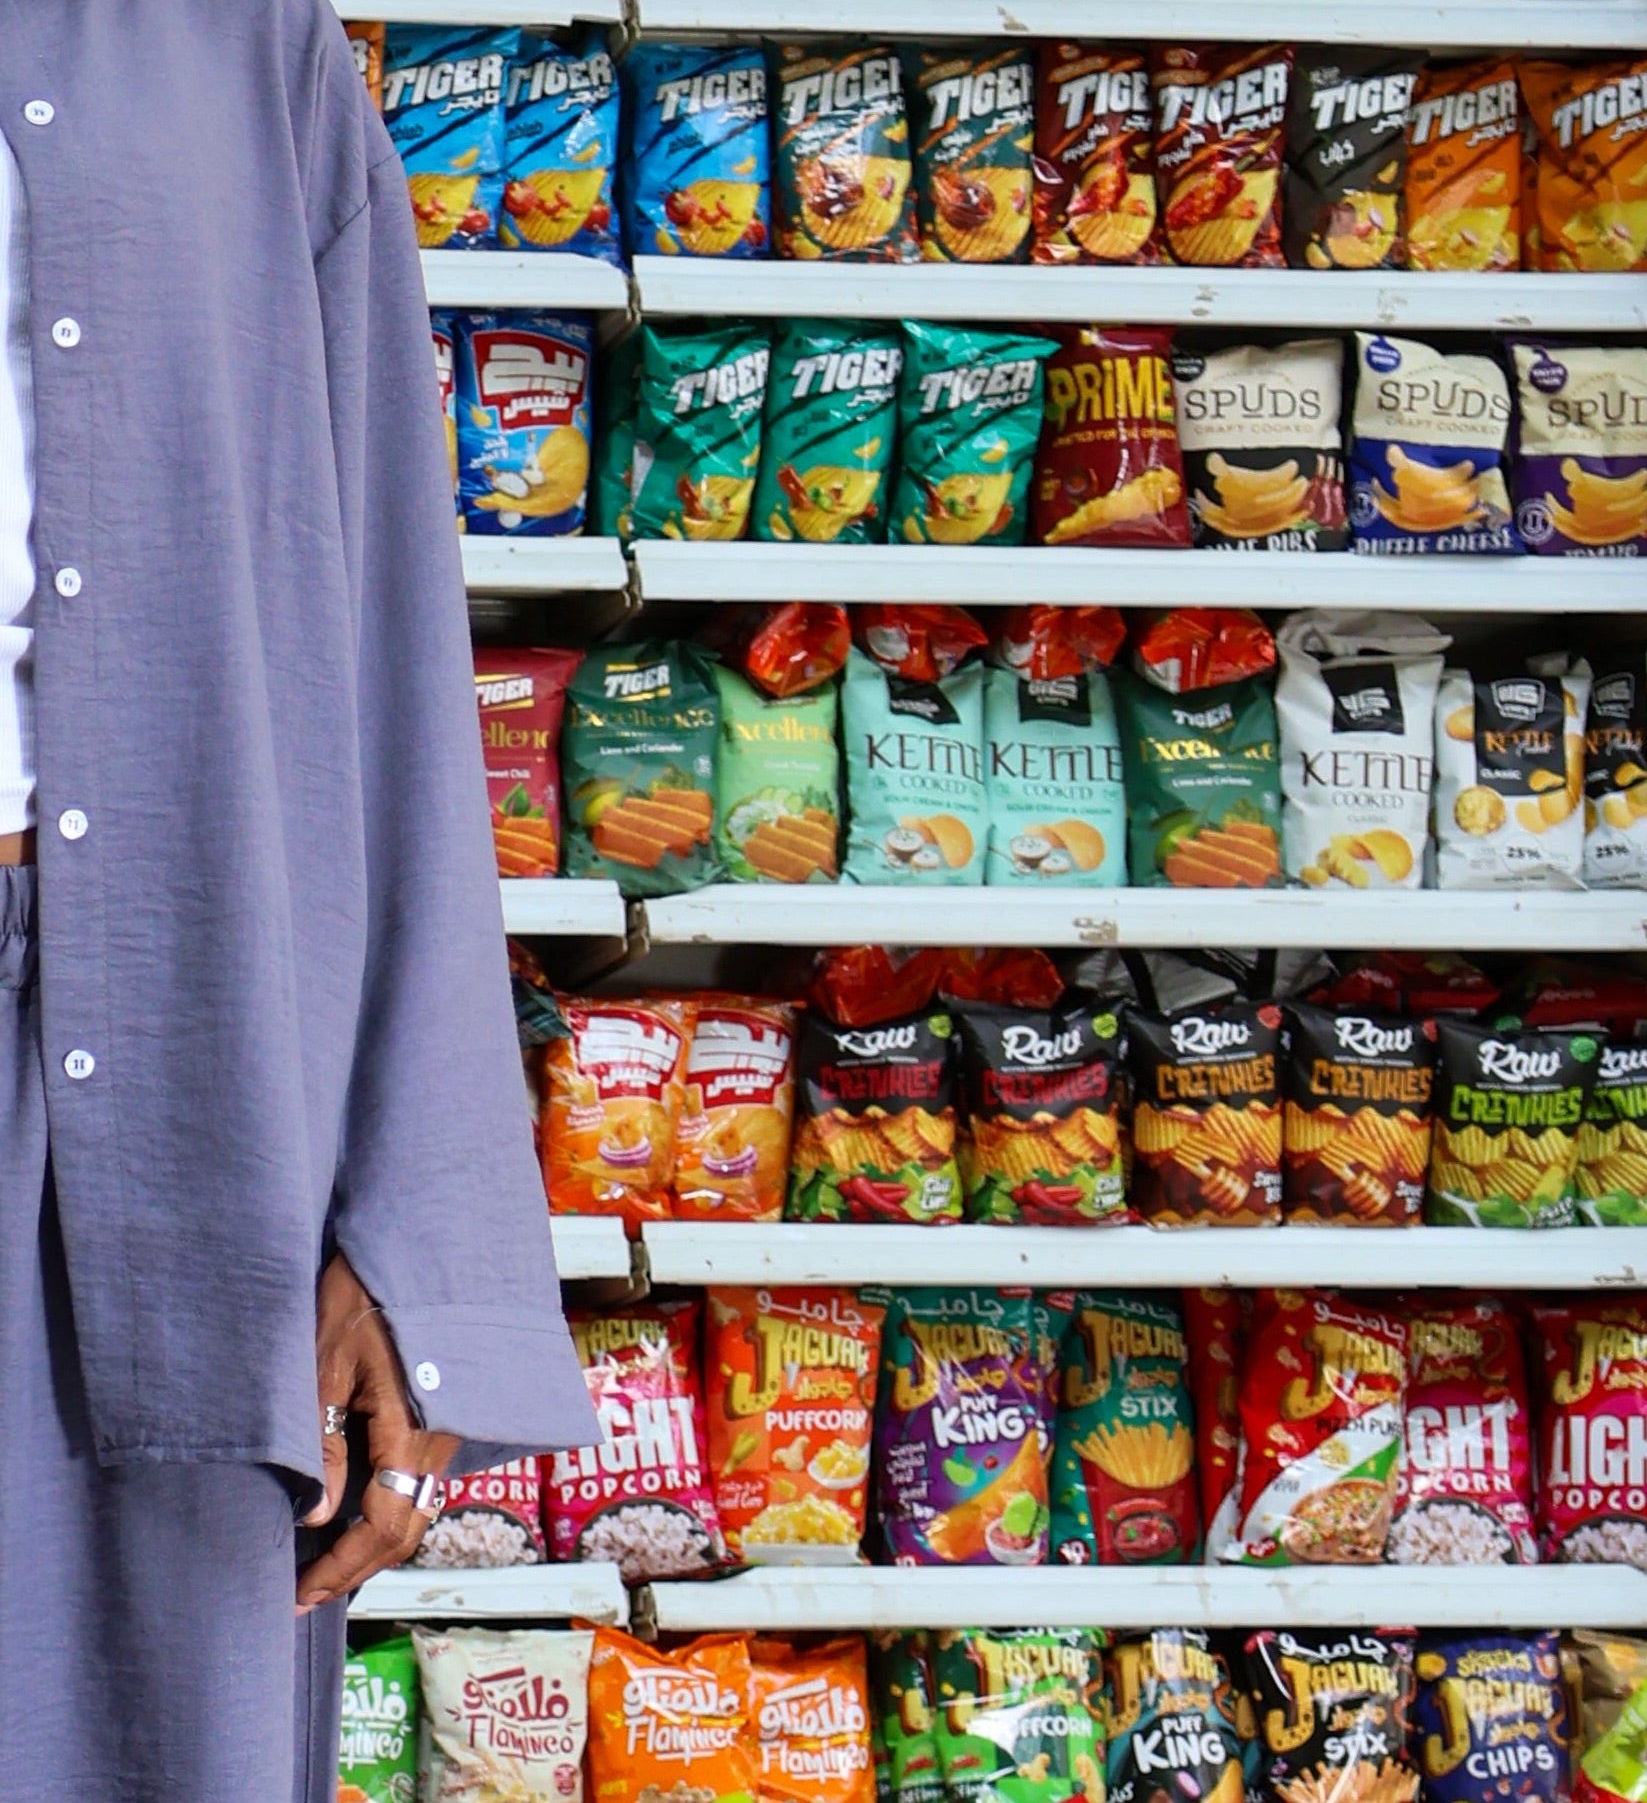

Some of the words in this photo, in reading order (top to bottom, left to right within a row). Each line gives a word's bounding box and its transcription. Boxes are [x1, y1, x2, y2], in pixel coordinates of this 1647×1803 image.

[384, 54, 503, 110] TIGER
[507, 53, 614, 107] TIGER
[657, 69, 766, 123] TIGER
[1160, 62, 1288, 129] TIGER
[1411, 79, 1517, 144] TIGER
[920, 360, 1036, 413] TIGER
[1049, 356, 1174, 430] PRIME
[1184, 382, 1322, 421] SPUDS
[1377, 378, 1511, 423] SPUDS
[604, 664, 670, 698] TIGER
[1301, 751, 1432, 792] KETTLE
[1332, 792, 1404, 809] COOKED
[1002, 1025, 1083, 1061] Raw
[1171, 1018, 1252, 1057] Raw
[1335, 1017, 1415, 1056] Raw
[1157, 1055, 1275, 1100] CRINKLES
[1312, 1058, 1432, 1102] CRINKLES
[1478, 1038, 1562, 1082] Raw
[820, 1065, 939, 1099] CRINKLES
[1452, 1085, 1583, 1126] CRINKLES
[731, 1314, 870, 1418] JAGUAR
[1067, 1312, 1187, 1407] JAGUAR
[766, 1410, 866, 1433] PUFFCORN
[933, 1406, 1025, 1448] KING
[1120, 1396, 1178, 1418] STIX
[562, 1468, 702, 1504] POPCORN
[1267, 1659, 1399, 1751] JAGUAR
[1133, 1733, 1227, 1772] KING
[1323, 1732, 1387, 1759] STIX
[1466, 1746, 1554, 1779] CHIPS
